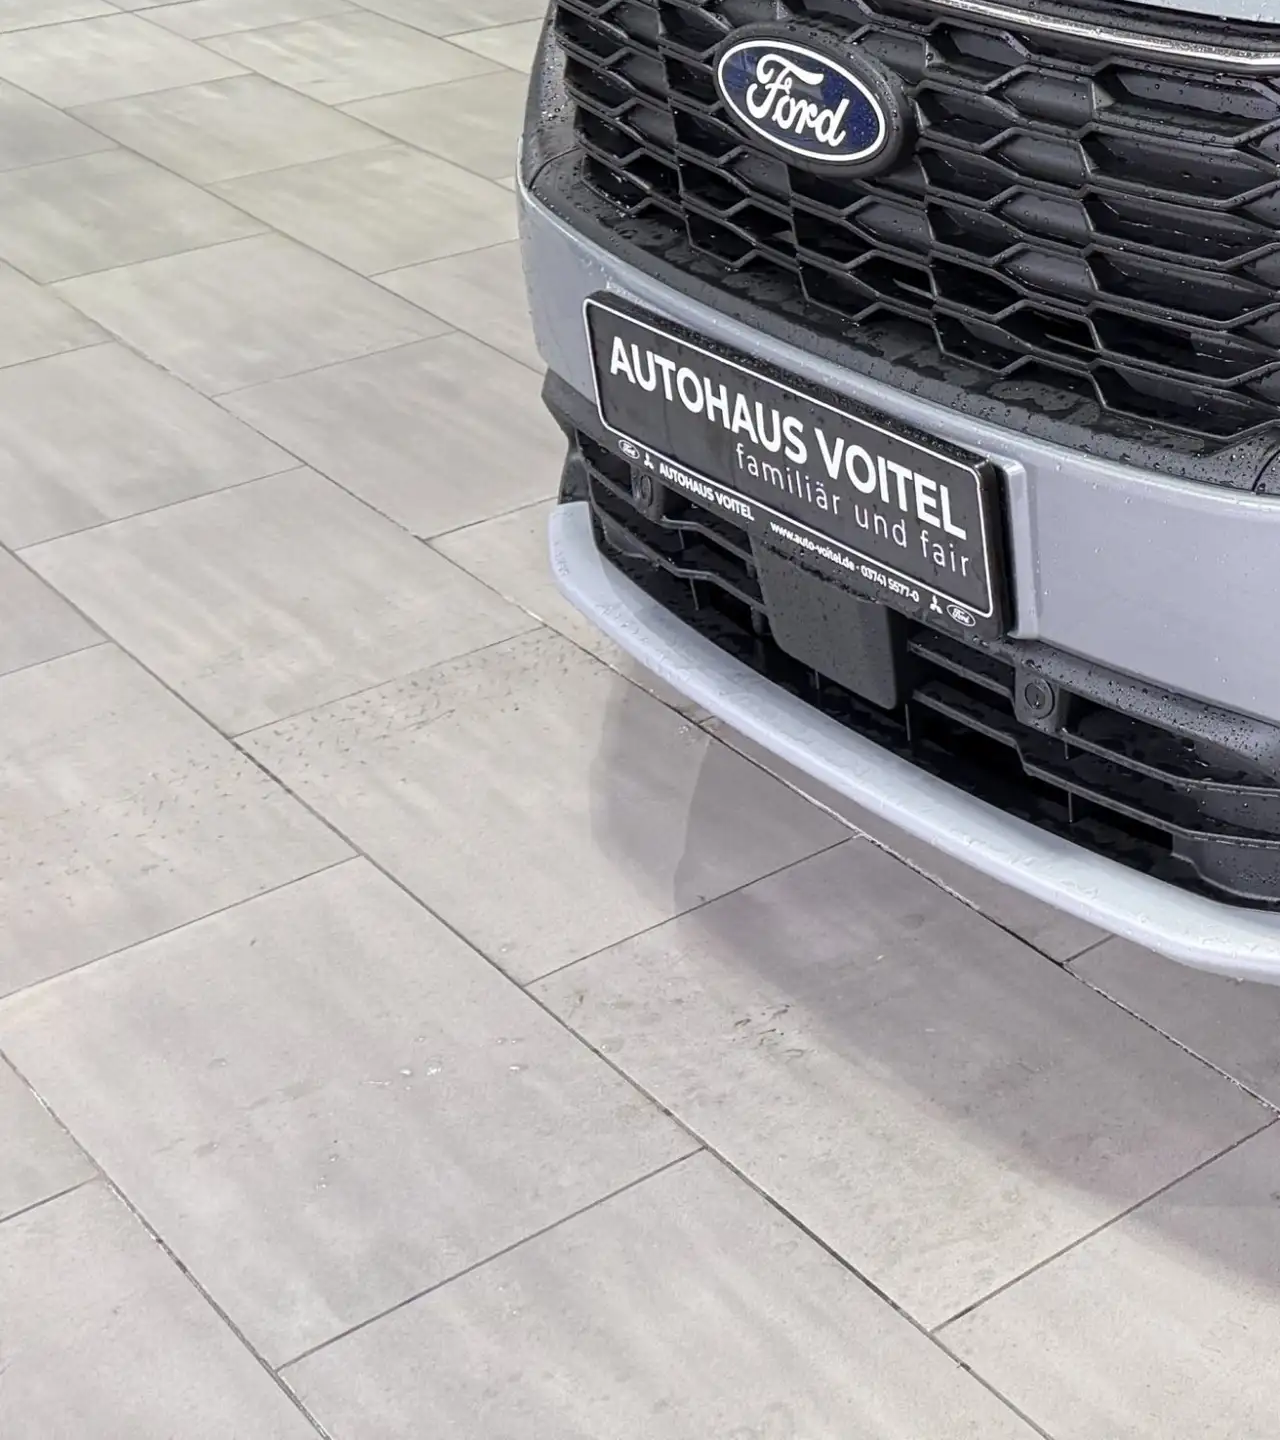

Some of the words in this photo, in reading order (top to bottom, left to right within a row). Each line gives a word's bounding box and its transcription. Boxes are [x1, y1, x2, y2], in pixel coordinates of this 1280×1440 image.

[746, 53, 850, 147] Ford
[610, 335, 808, 465] AUTOHAUS
[814, 427, 967, 541] VOITEL
[659, 462, 715, 502] AUTOHAUS
[714, 491, 756, 522] VOITEL
[736, 442, 841, 515] familiär
[854, 503, 907, 548] und
[919, 529, 970, 577] fair
[769, 521, 855, 572] www.auto-voitel.de
